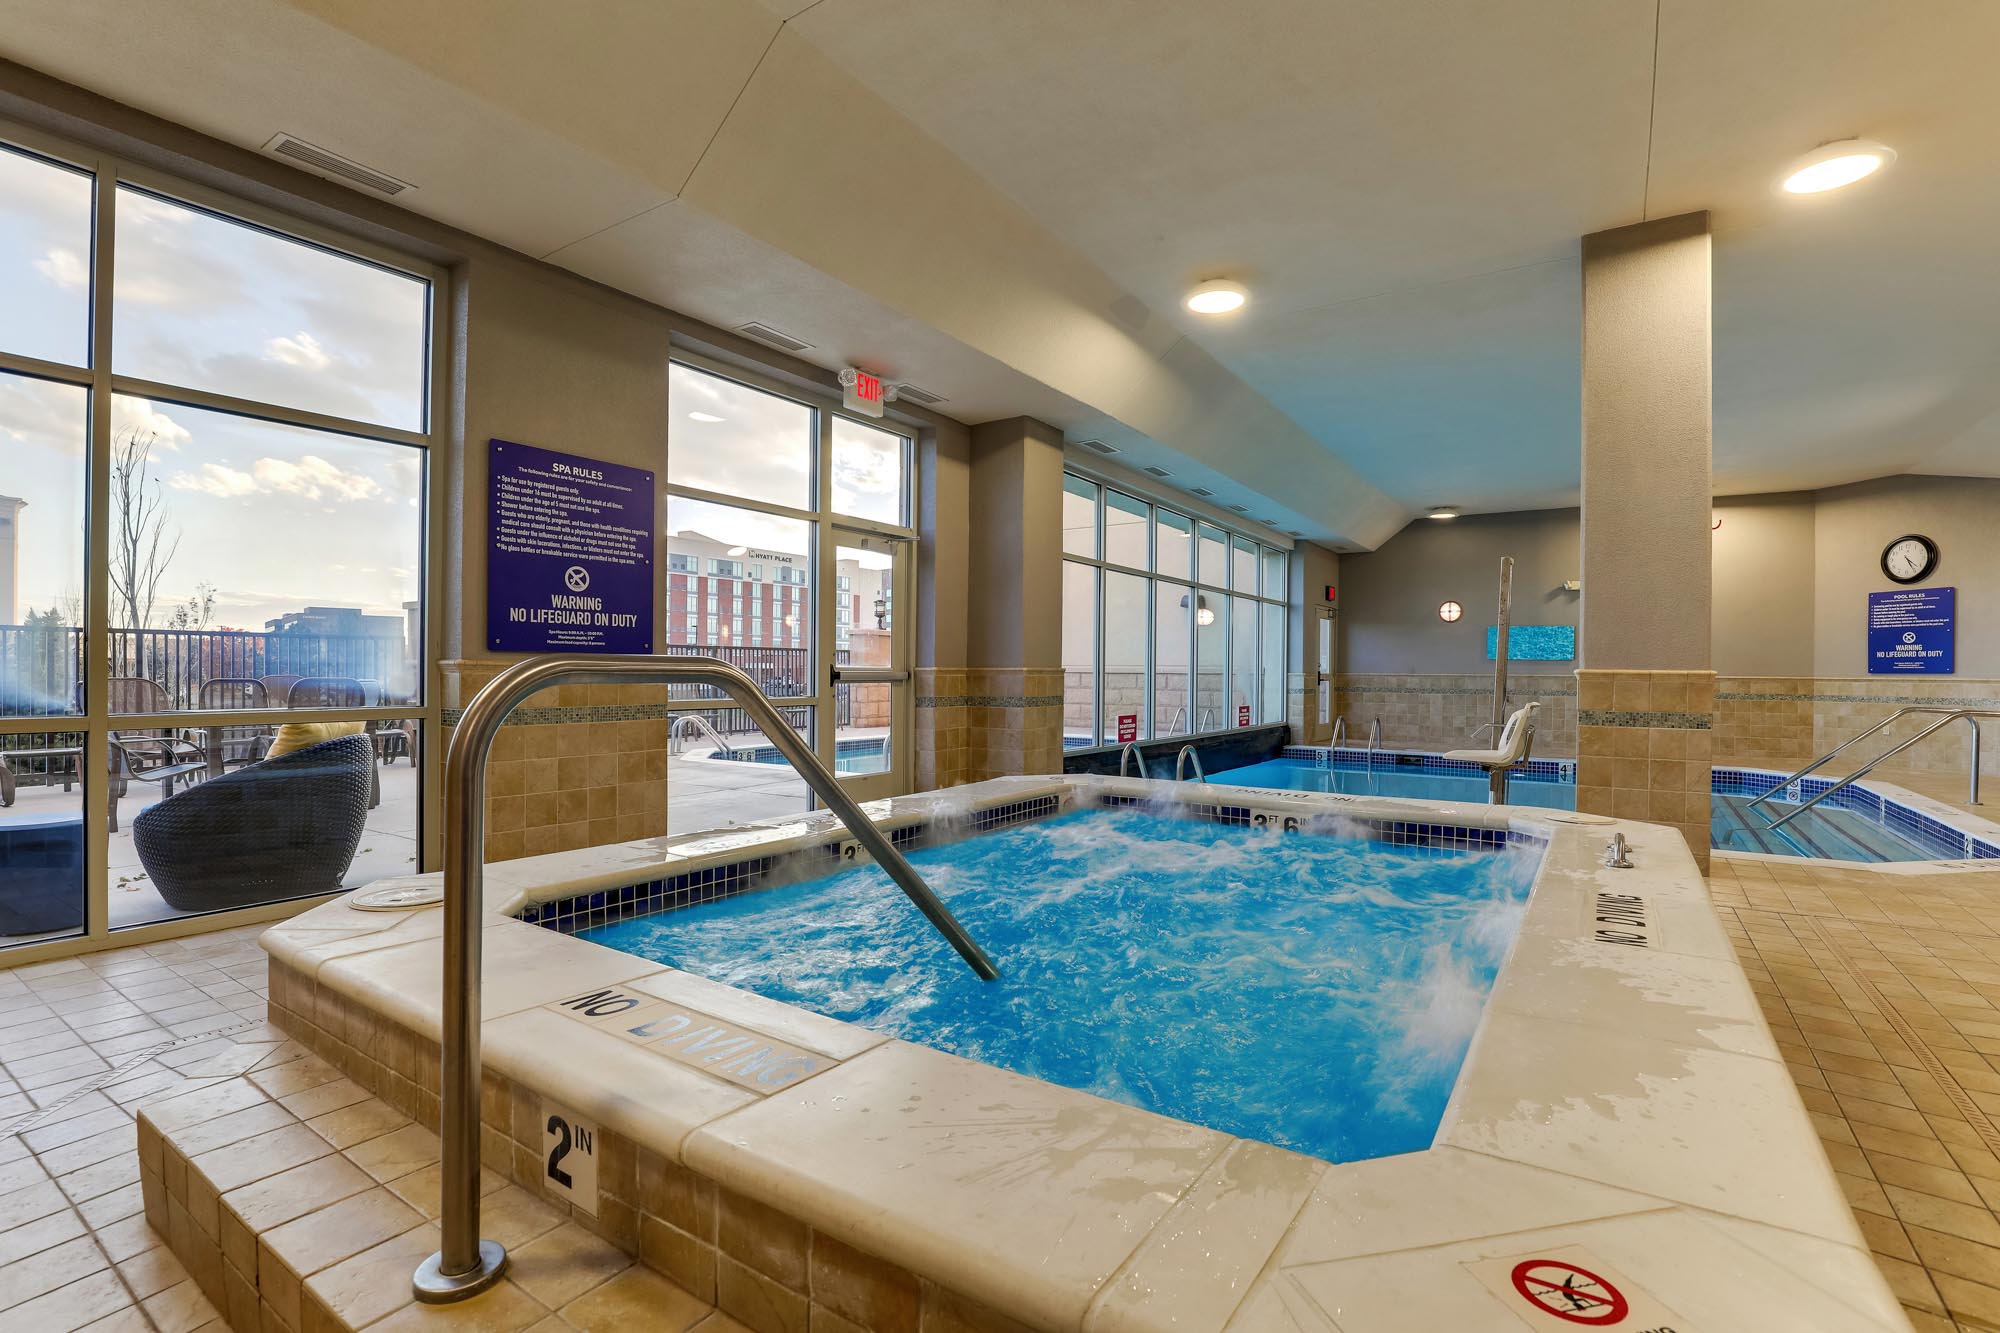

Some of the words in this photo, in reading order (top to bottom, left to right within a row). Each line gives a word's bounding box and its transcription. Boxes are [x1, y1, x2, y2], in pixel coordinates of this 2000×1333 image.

[857, 372, 879, 402] EXIT
[552, 463, 571, 474] SPA
[573, 467, 602, 480] RULES
[502, 484, 520, 492] Children
[558, 494, 580, 502] supervised
[502, 492, 520, 500] Children
[534, 506, 551, 515] entering
[607, 533, 622, 541] entering
[551, 594, 602, 611] WARNING
[510, 607, 526, 622] NO
[530, 609, 591, 625] LIFEGUARD
[594, 612, 608, 626] ON
[612, 614, 637, 627] DUTY
[739, 752, 742, 760] 3
[1560, 765, 1567, 773] 4
[1269, 815, 1278, 823] FT
[1284, 817, 1298, 832] 6
[1596, 894, 1645, 927] DIVING
[1594, 930, 1648, 948] NO
[560, 990, 640, 1016] NO
[626, 1014, 816, 1085] DIVING
[547, 1115, 572, 1189] 2
[575, 1125, 592, 1156] IN
